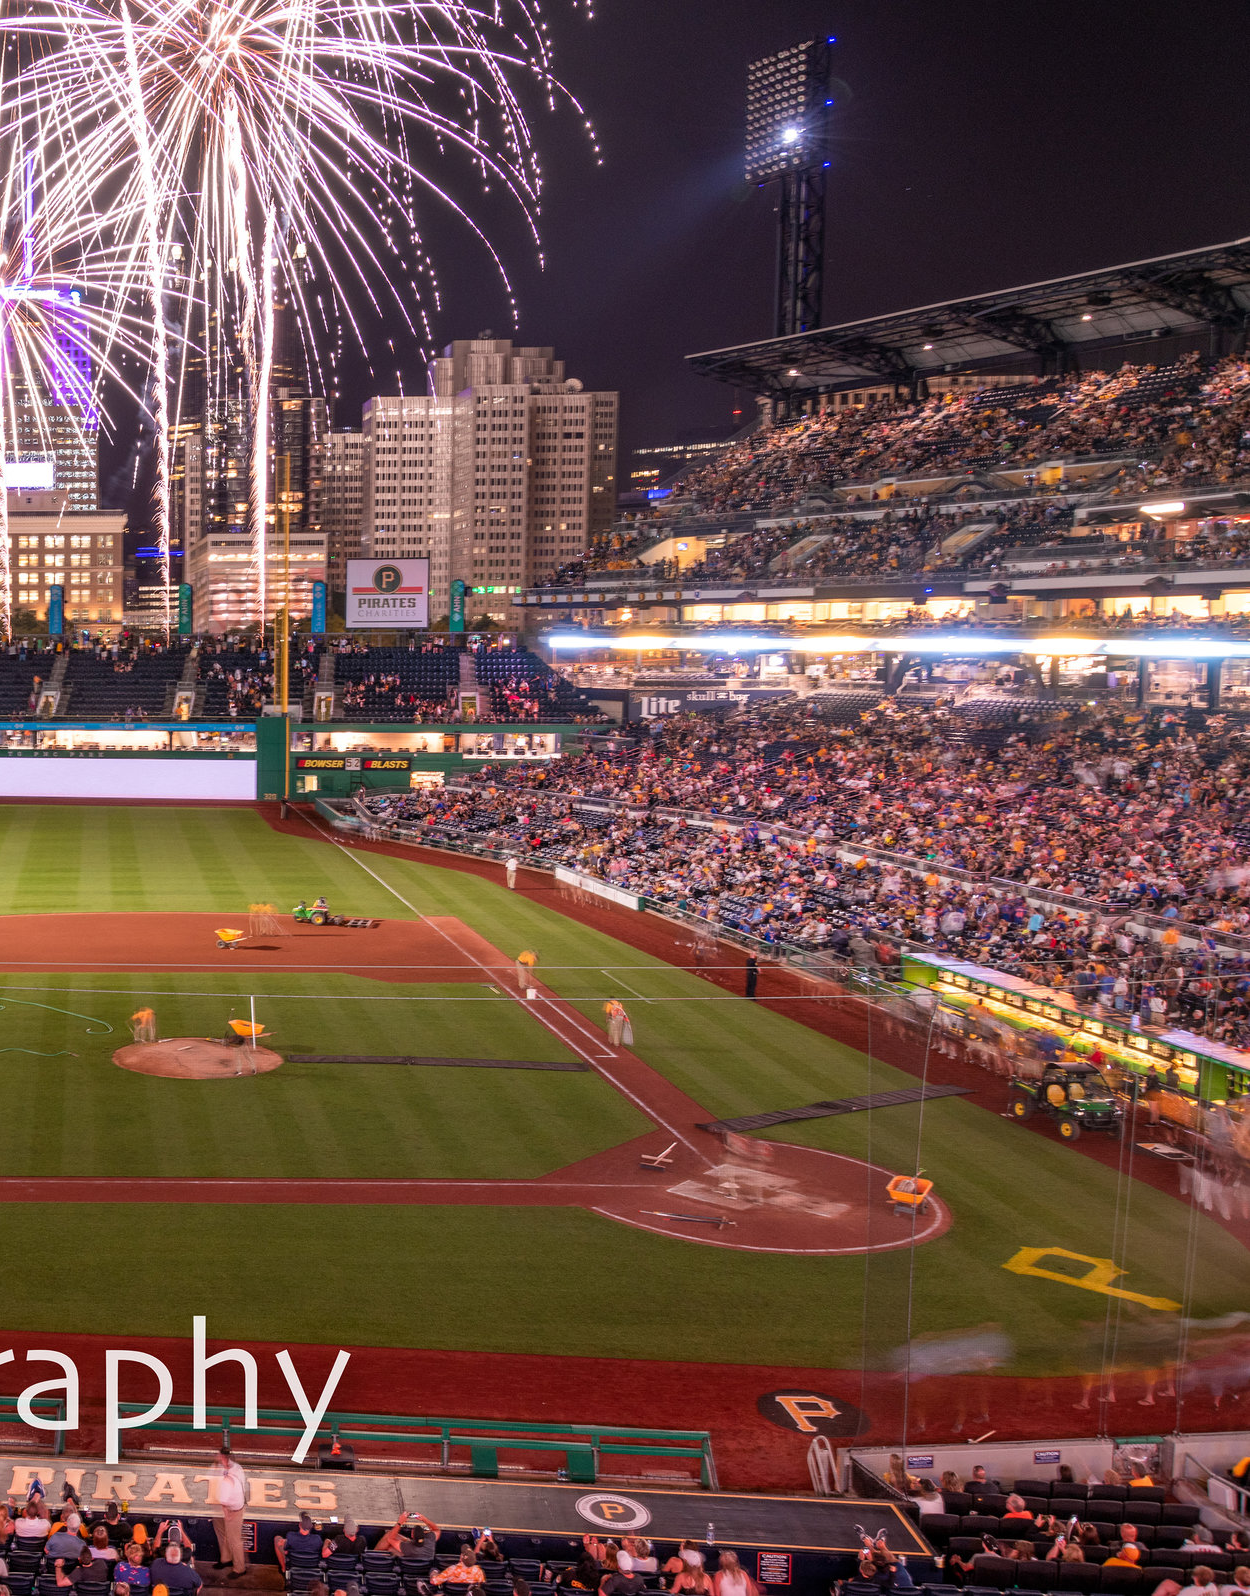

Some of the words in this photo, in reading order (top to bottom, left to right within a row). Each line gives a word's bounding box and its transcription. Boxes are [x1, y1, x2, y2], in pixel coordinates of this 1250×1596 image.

[358, 597, 417, 608] PIRATES
[453, 596, 461, 612] AHN
[358, 609, 417, 617] CHARITIES
[686, 690, 716, 701] skull
[640, 697, 681, 718] Lite
[304, 759, 344, 768] BOWSER
[370, 760, 409, 769] BLASTS
[7, 1465, 338, 1511] PIRATES
